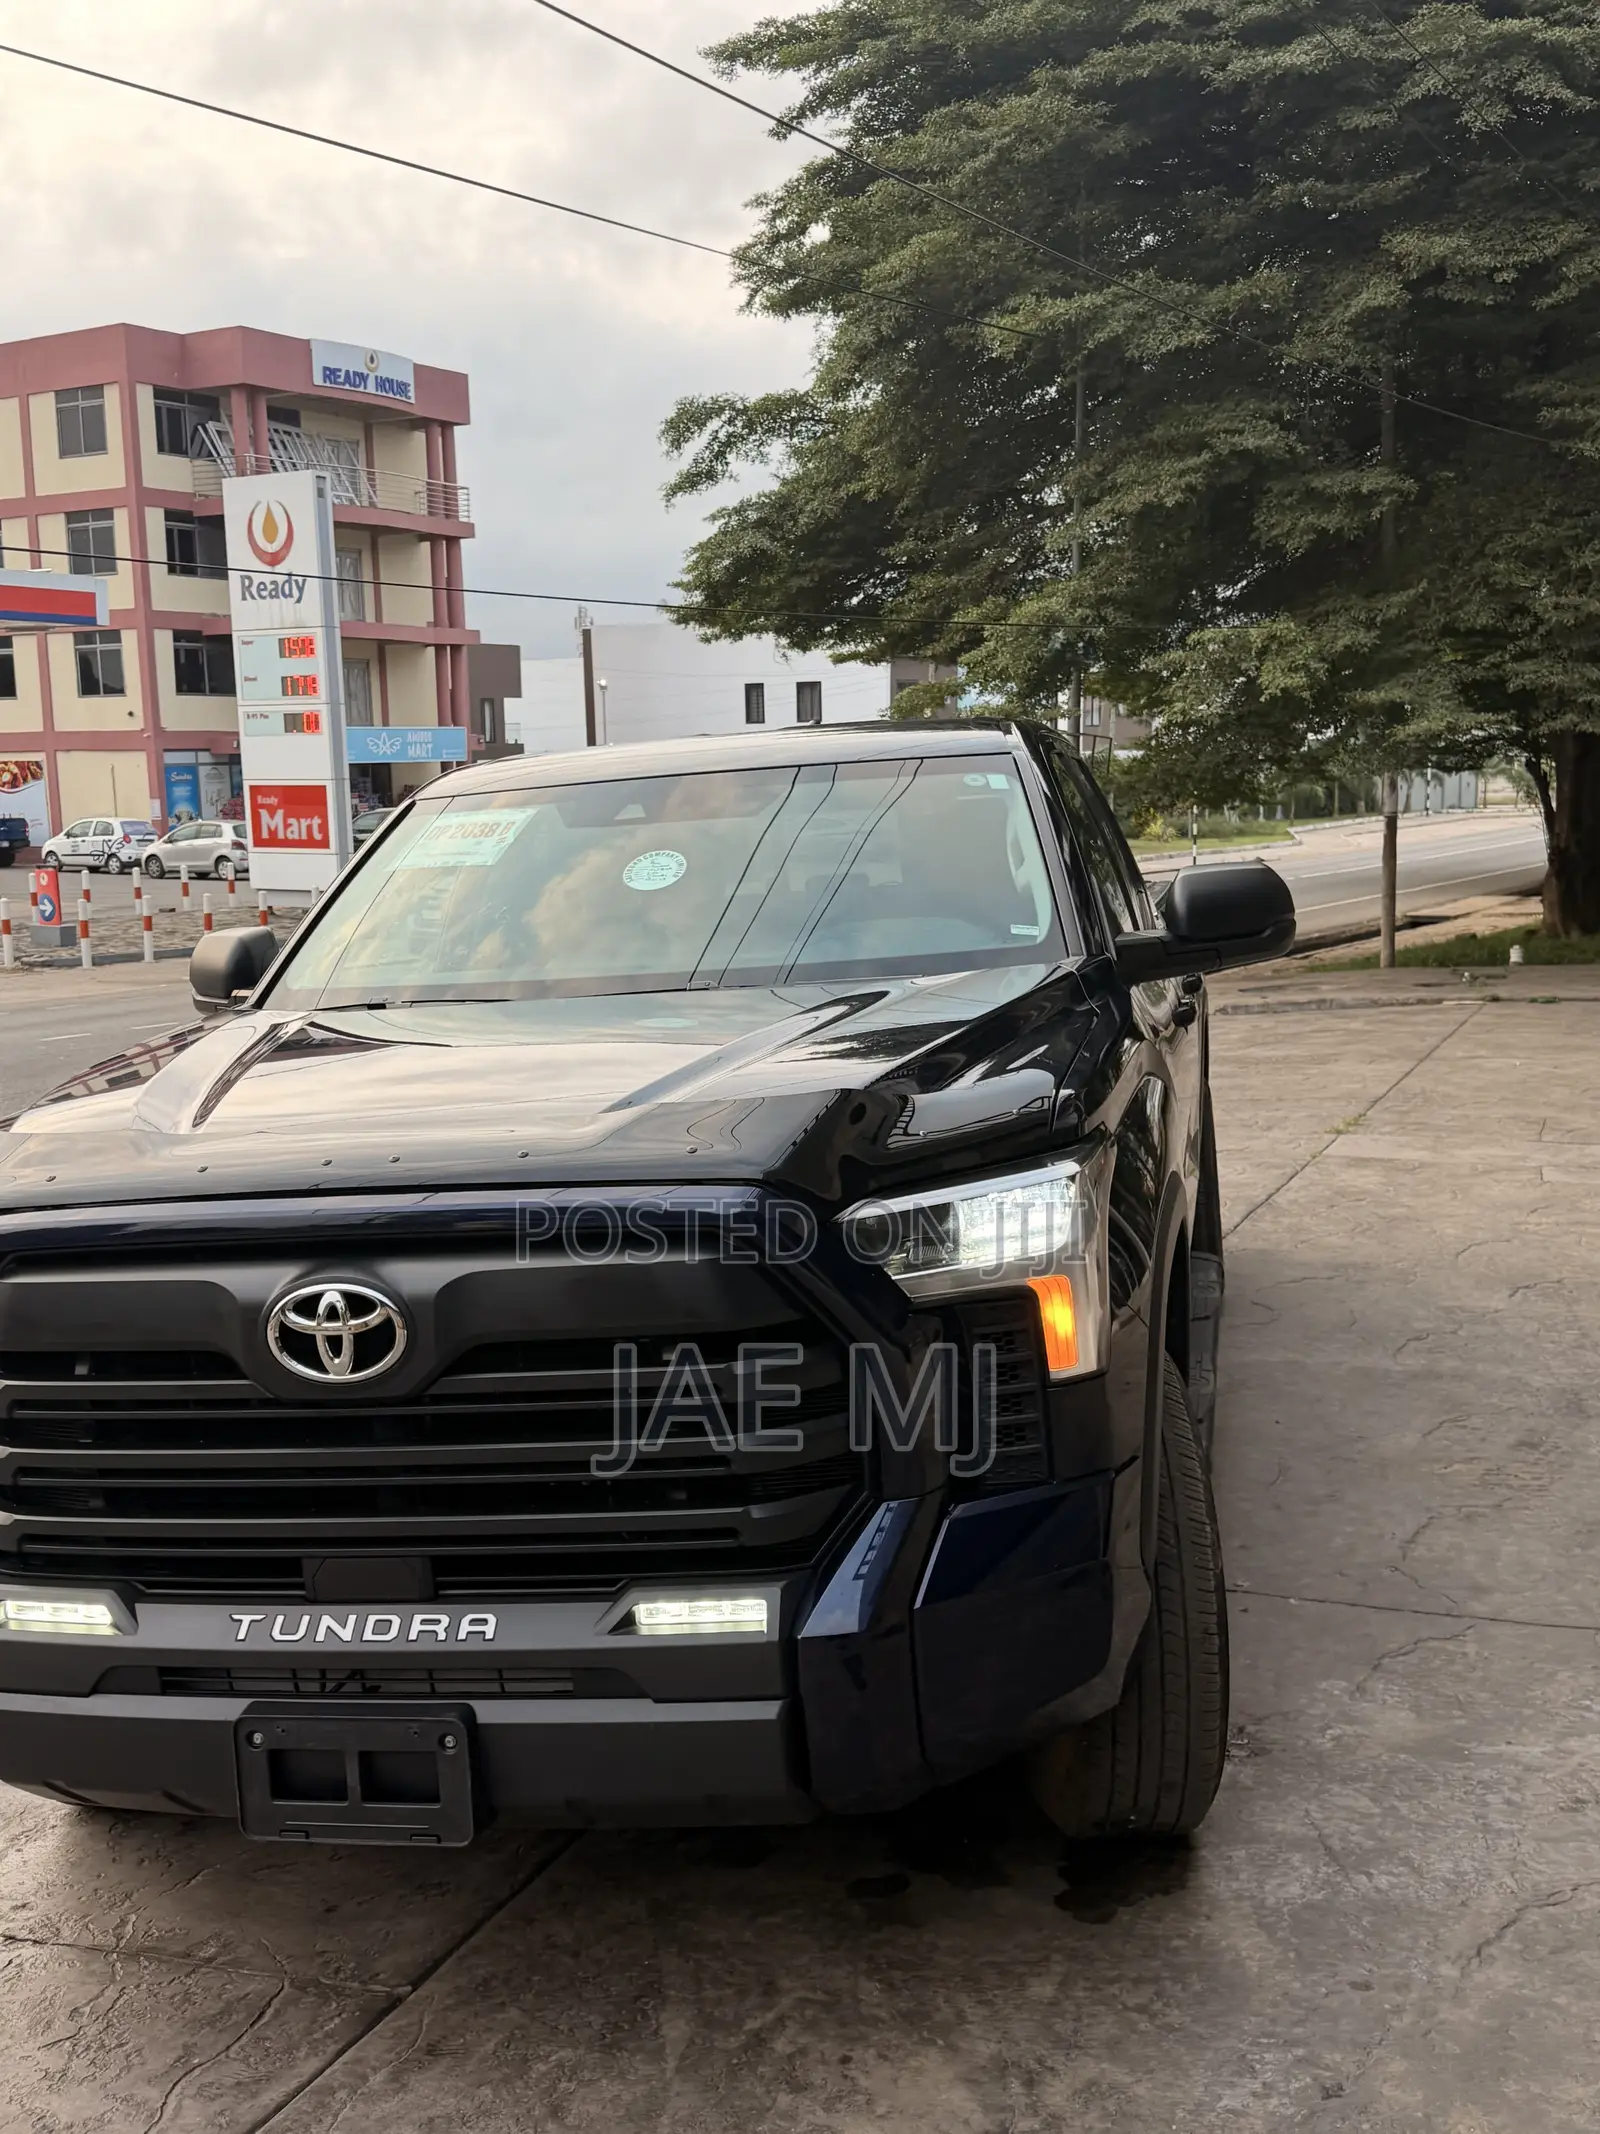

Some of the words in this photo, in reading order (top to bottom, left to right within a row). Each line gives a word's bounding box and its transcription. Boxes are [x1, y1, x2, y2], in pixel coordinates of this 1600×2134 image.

[322, 365, 369, 390] READY
[374, 375, 412, 400] HOUSE
[240, 571, 307, 604] Ready
[408, 743, 433, 758] MART
[257, 795, 278, 806] Ready
[258, 808, 323, 840] Mart
[229, 1613, 498, 1643] TUNDRA
